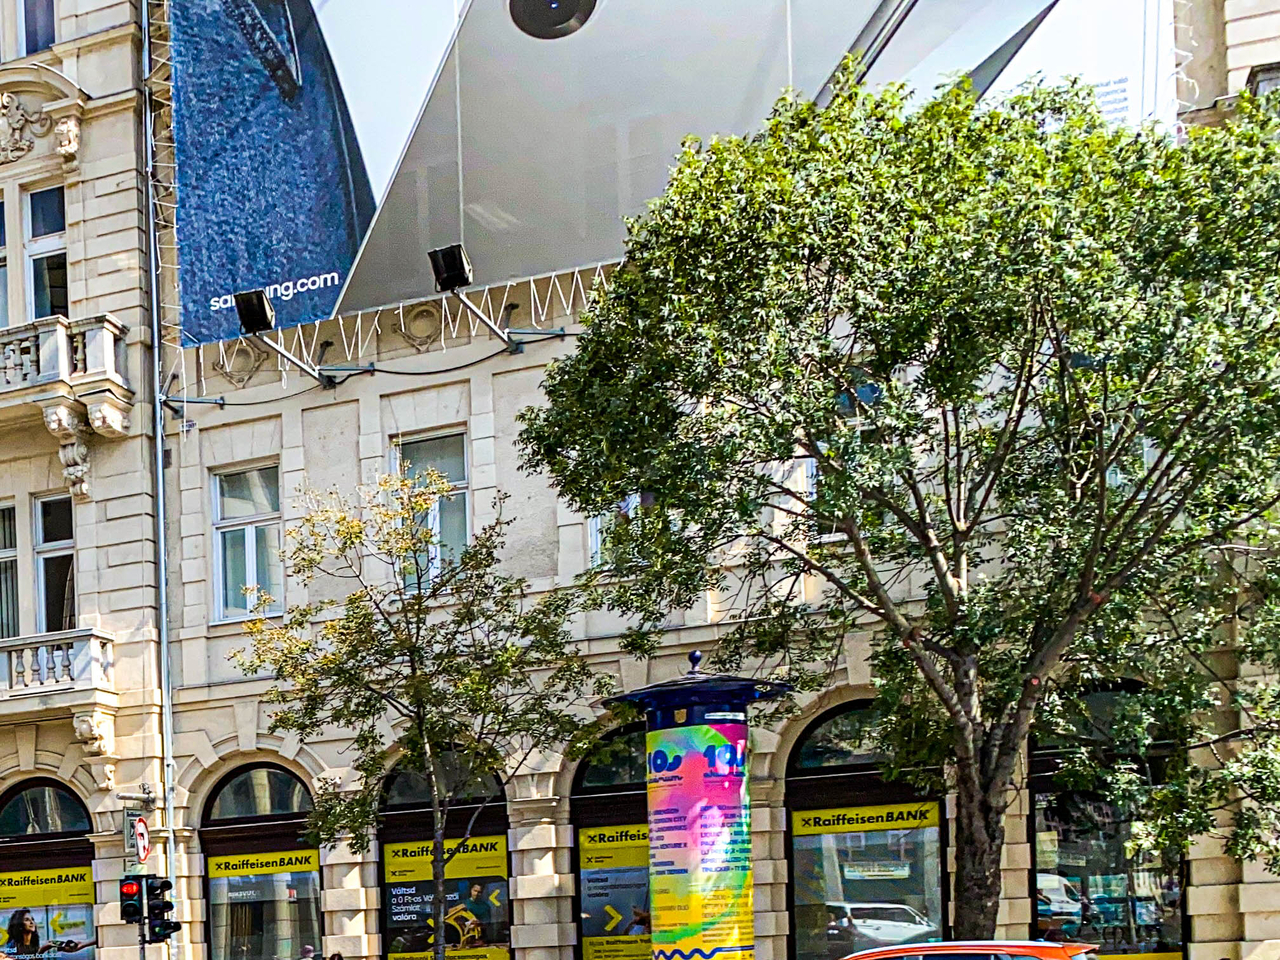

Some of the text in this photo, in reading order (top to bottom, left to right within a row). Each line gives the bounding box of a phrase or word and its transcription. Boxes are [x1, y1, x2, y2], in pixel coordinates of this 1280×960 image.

[813, 809, 930, 827] RaiffeisenBANK
[224, 855, 312, 871] RaiffeisenBANK
[7, 873, 87, 887] RaiffeisenBANK
[392, 913, 417, 921] valóra
